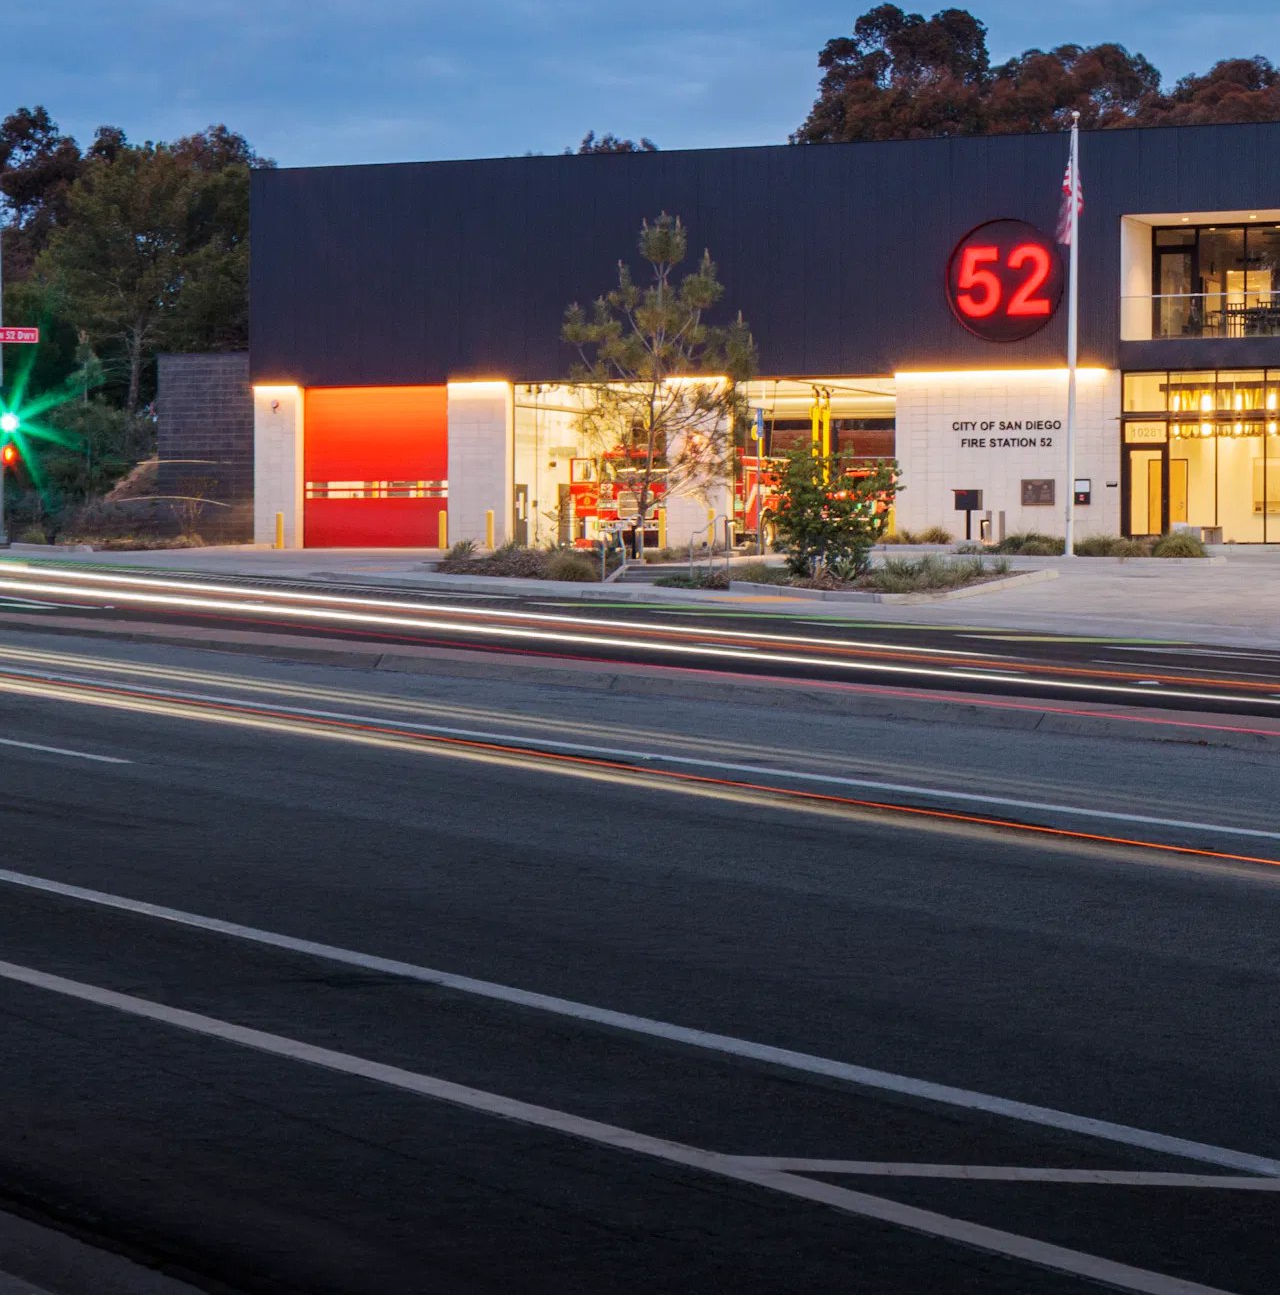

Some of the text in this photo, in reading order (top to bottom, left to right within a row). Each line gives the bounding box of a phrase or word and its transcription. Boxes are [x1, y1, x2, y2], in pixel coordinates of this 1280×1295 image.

[956, 243, 1051, 318] 52
[5, 331, 15, 340] 52
[952, 420, 1062, 431] CITY OF SAN DIEGO
[961, 437, 1052, 448] FIRE STATION 52
[600, 483, 614, 493] 52
